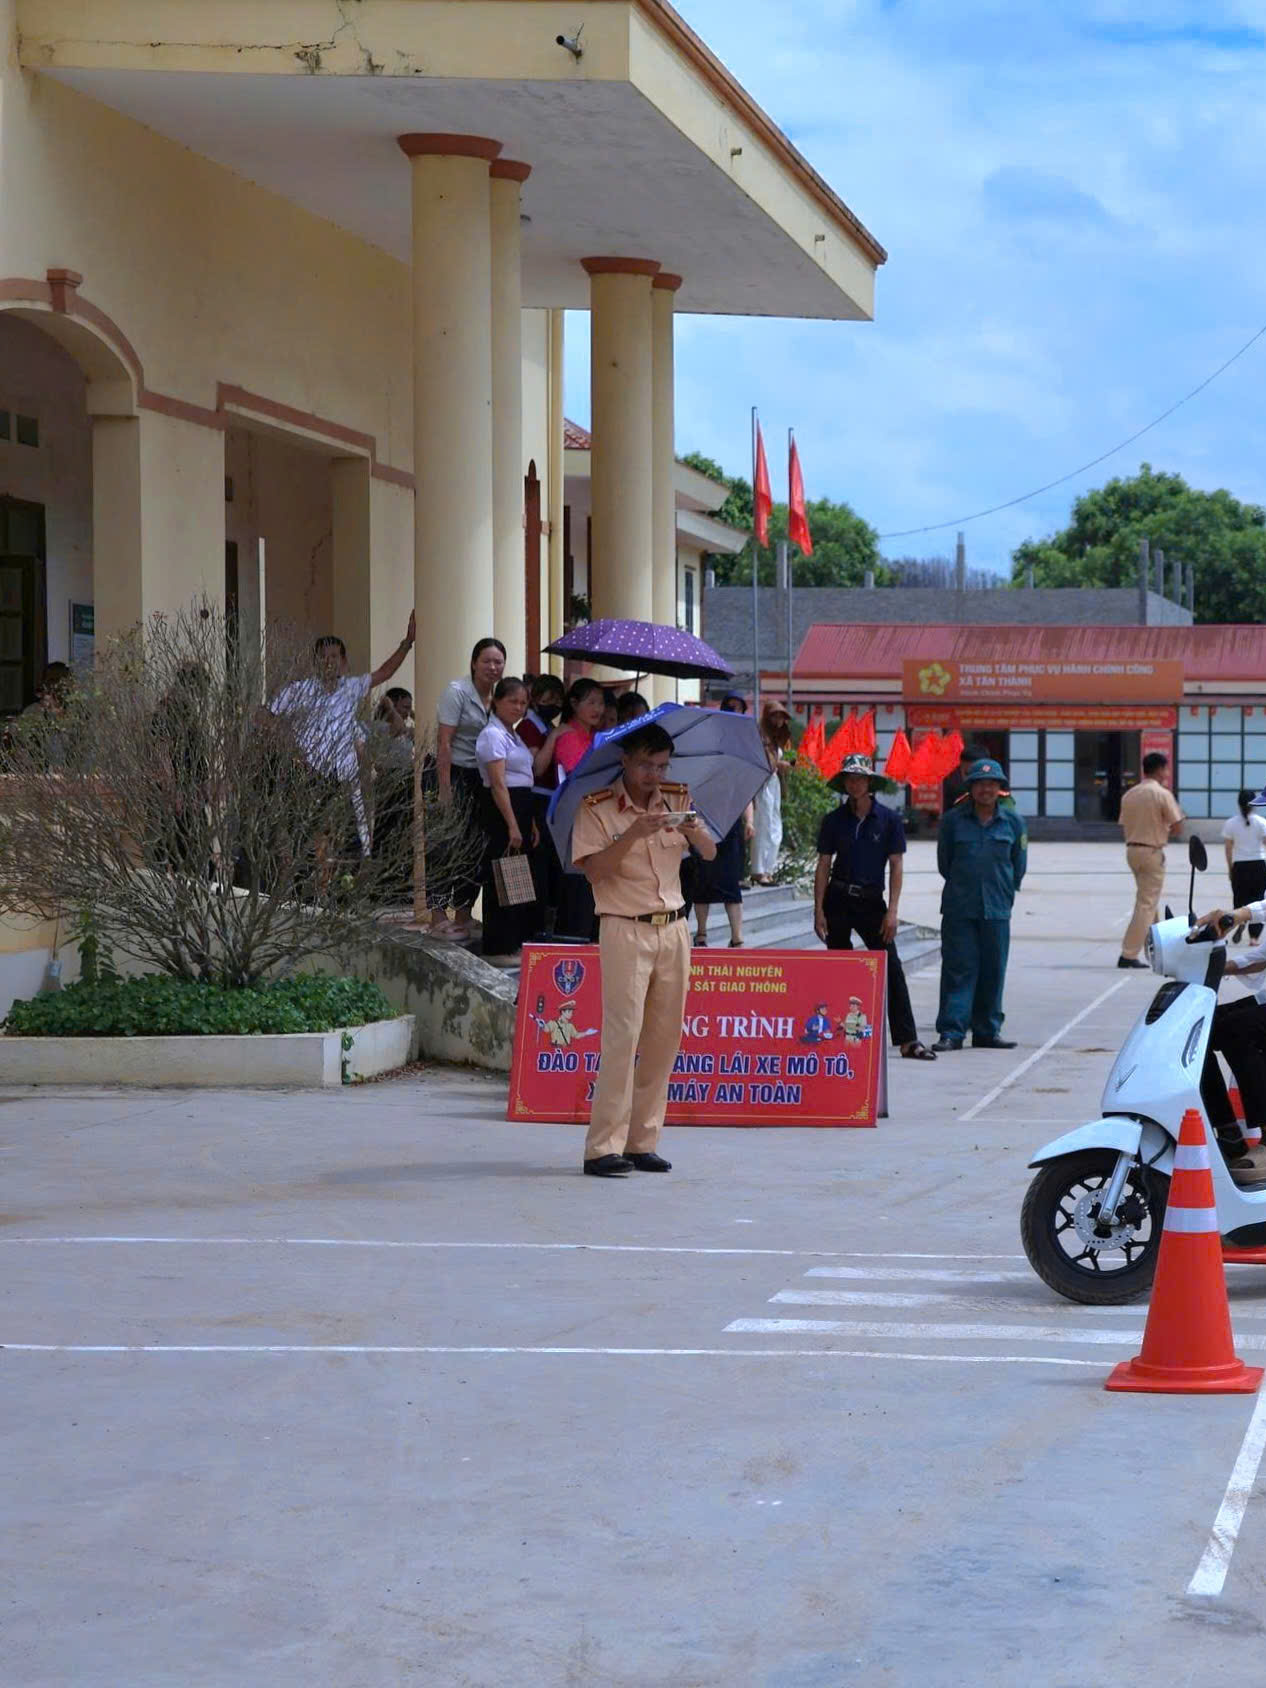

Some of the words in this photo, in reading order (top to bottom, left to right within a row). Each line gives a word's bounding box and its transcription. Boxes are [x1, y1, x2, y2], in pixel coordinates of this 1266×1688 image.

[708, 964, 733, 977] THÁI
[736, 964, 782, 977] NGUYÊN
[694, 981, 715, 992] SÁT
[719, 982, 746, 992] GIAO
[750, 982, 787, 993] THÔNG
[716, 1010, 795, 1039] TRÌNH
[537, 1048, 579, 1072] ĐÀO
[719, 1051, 750, 1075] LÁI
[755, 1055, 781, 1075] XE
[786, 1052, 818, 1076] MÔ
[825, 1053, 855, 1079] TÔ,
[667, 1079, 712, 1103] MÁY
[714, 1082, 744, 1104] AN
[749, 1080, 801, 1105] TOÀN
